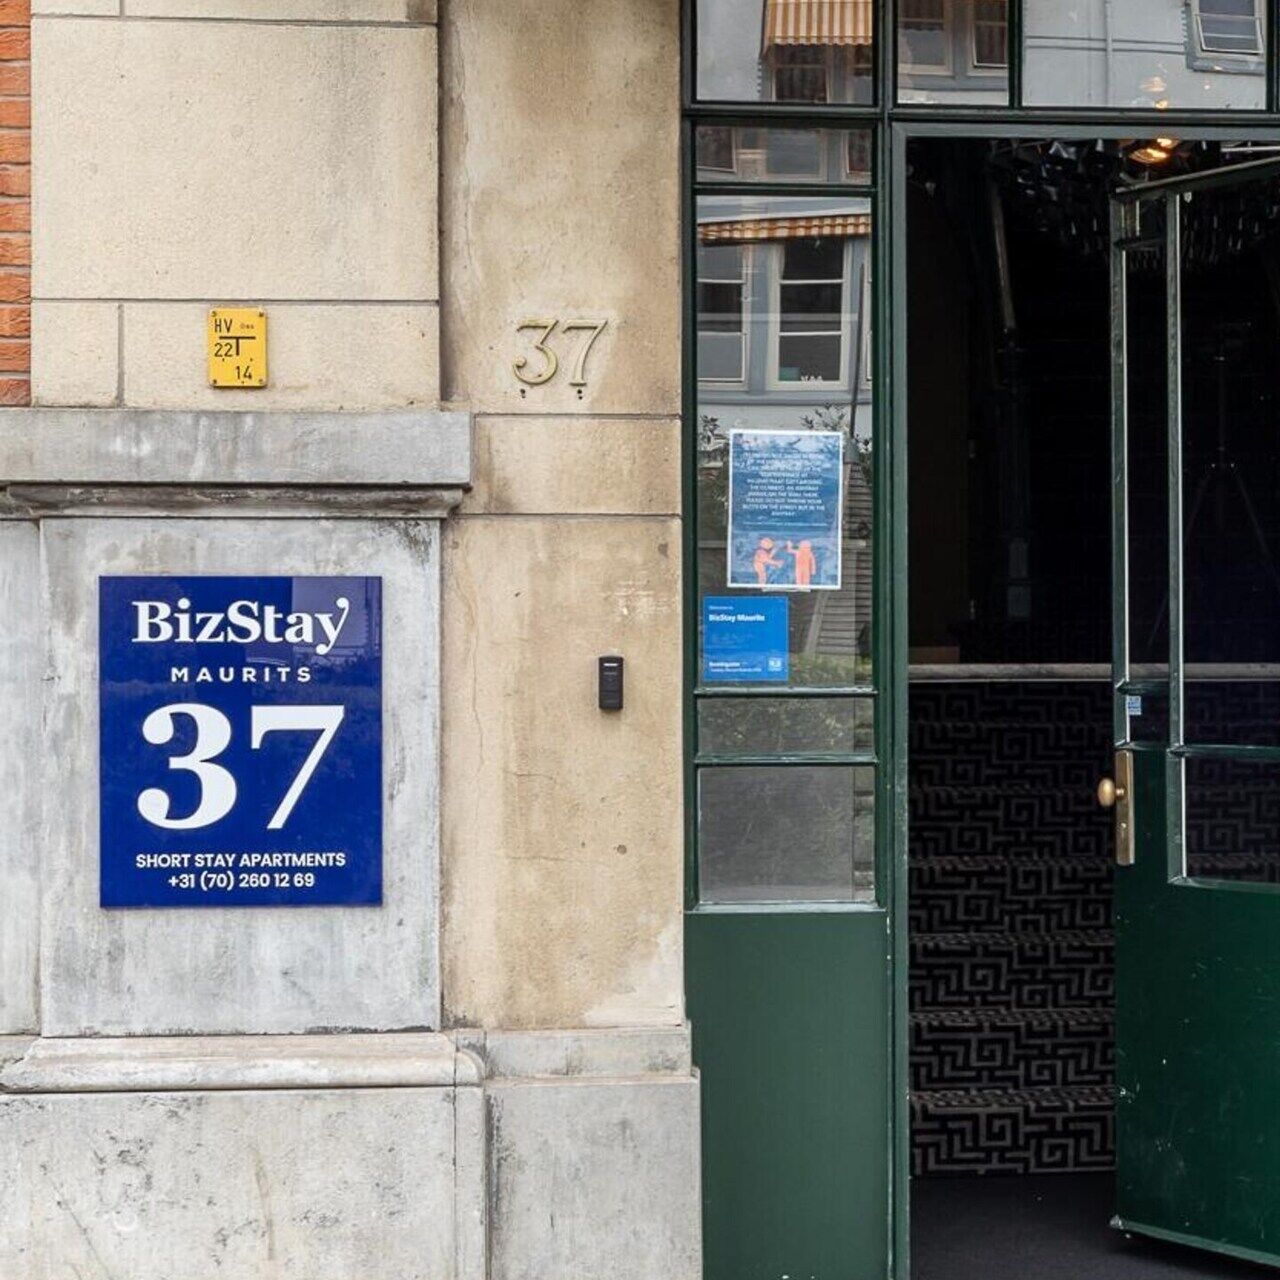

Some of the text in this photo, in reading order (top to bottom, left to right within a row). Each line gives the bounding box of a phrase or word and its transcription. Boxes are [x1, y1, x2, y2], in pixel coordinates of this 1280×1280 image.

[214, 318, 233, 333] HV
[512, 318, 608, 387] 37
[131, 597, 350, 655] BizStay
[171, 667, 312, 682] MAURITS
[137, 703, 345, 830] 37
[136, 852, 346, 868] SHORT STAY APARTMENTS
[168, 870, 315, 891] +31 (70) 260 12 69
